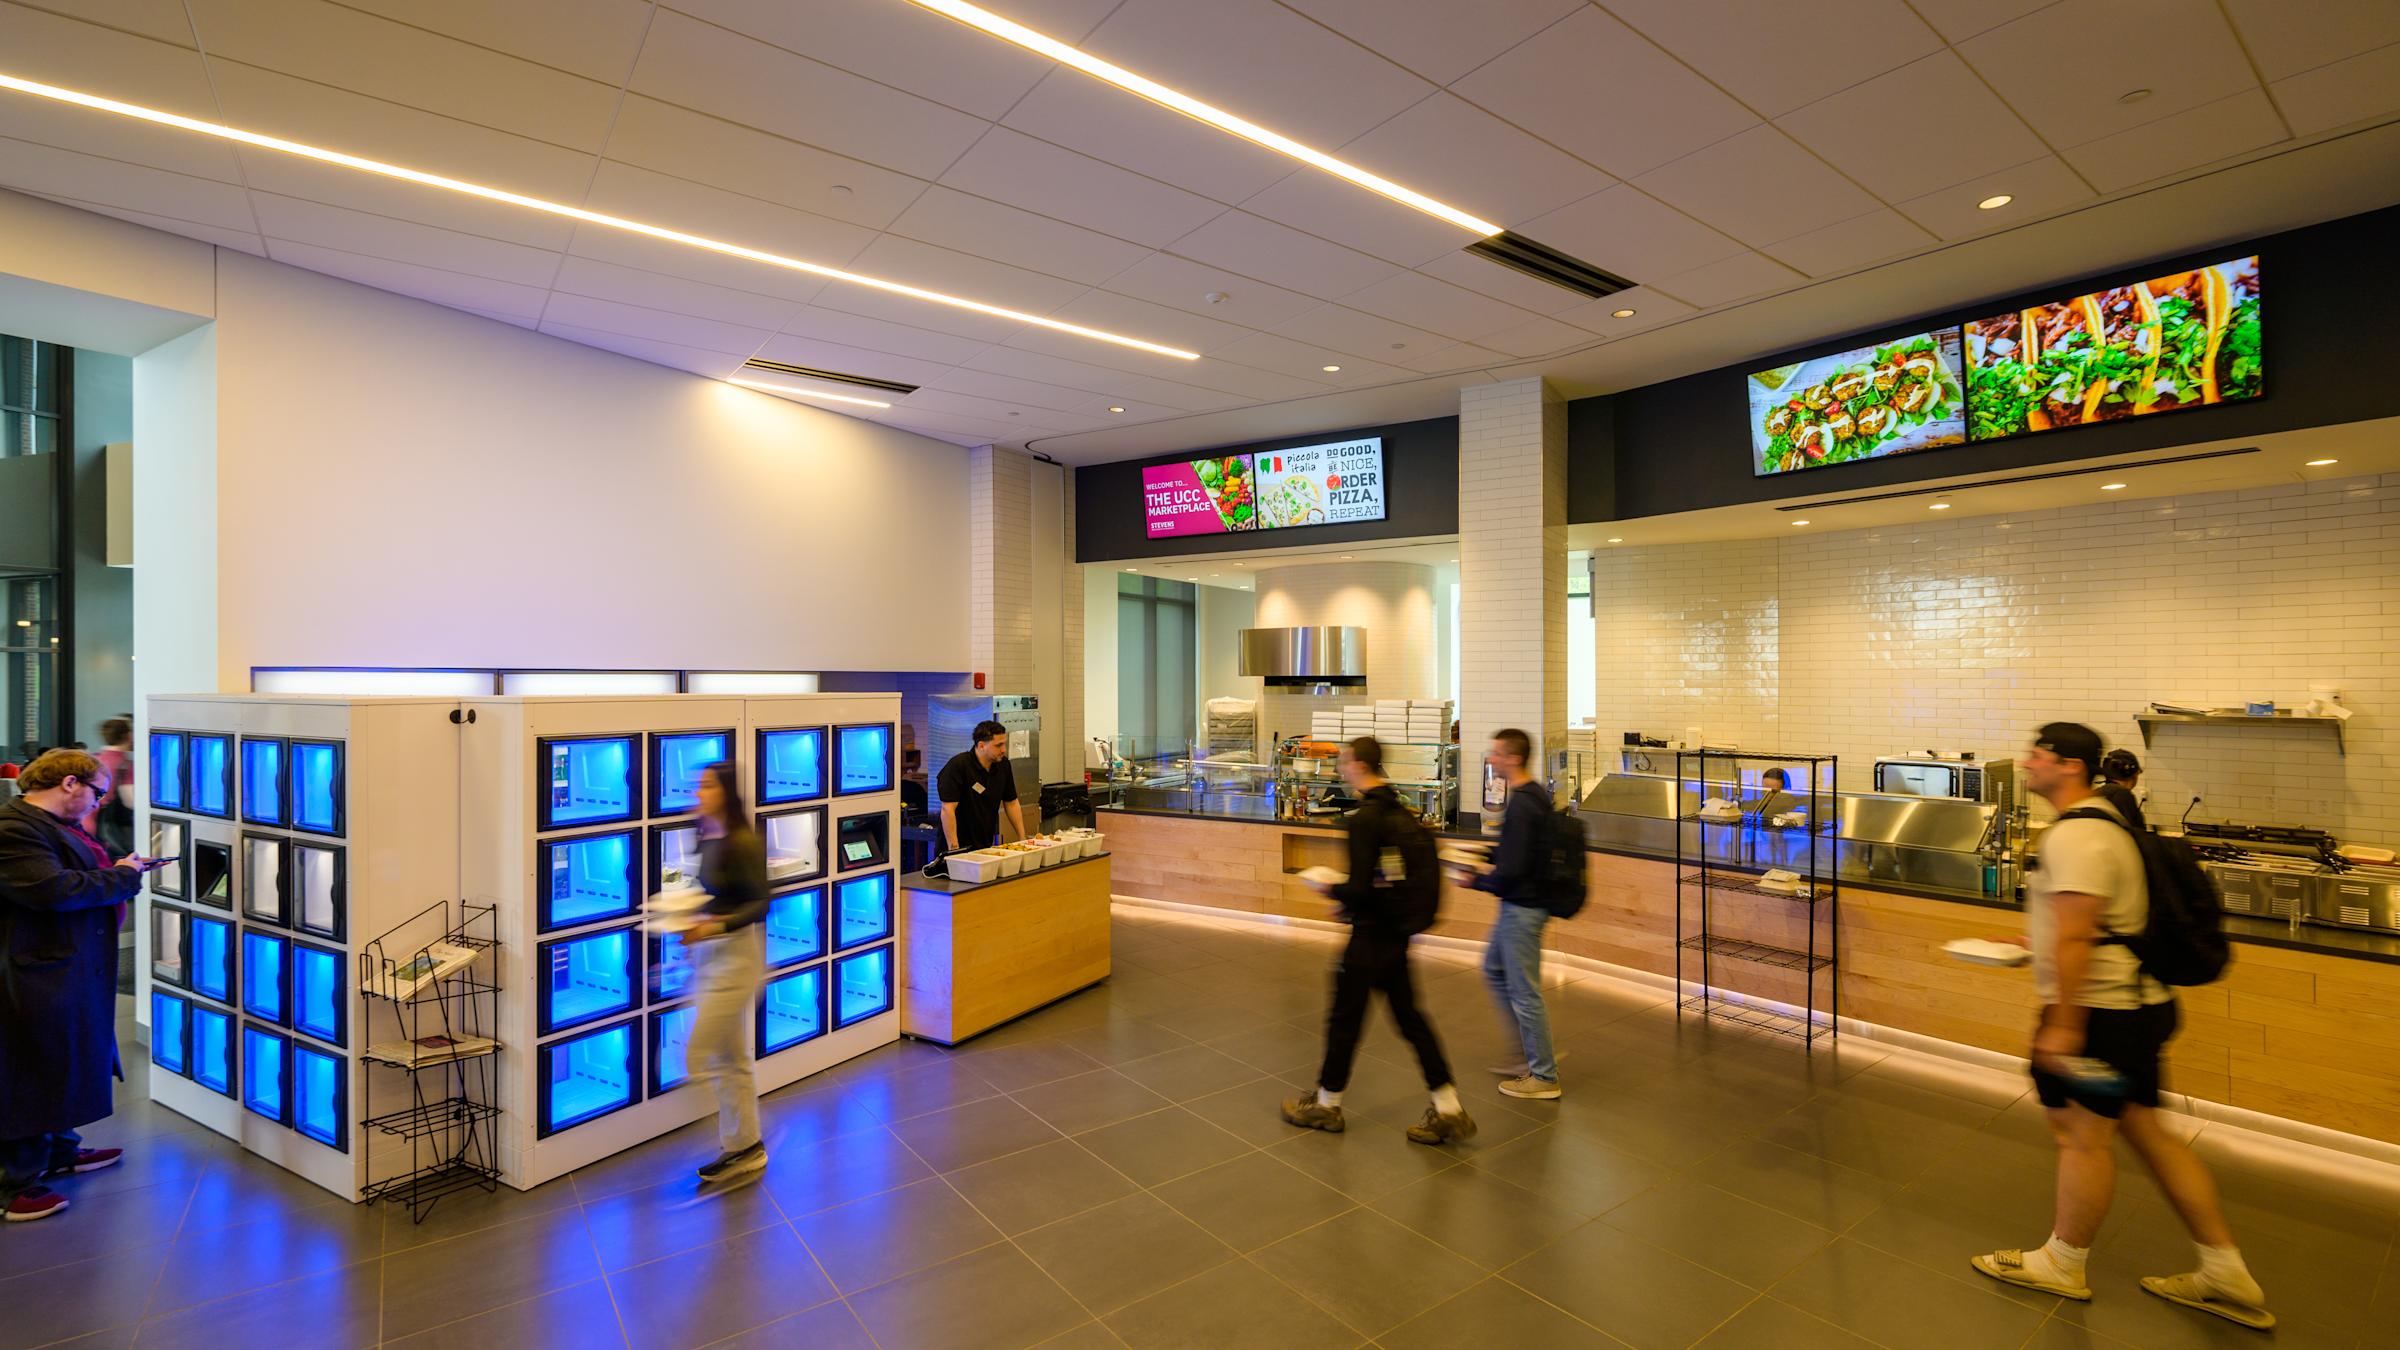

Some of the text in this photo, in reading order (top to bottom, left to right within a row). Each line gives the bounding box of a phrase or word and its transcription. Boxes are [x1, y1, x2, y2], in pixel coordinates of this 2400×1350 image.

[1327, 444, 1376, 457] DO GOOD,
[1287, 451, 1320, 465] piccola
[1291, 463, 1316, 473] italia
[1328, 458, 1377, 472] BE NICE,
[1146, 481, 1174, 490] WELCOME
[1146, 489, 1201, 507] THE UCC
[1329, 489, 1378, 506] PIZZA,
[1148, 502, 1211, 517] MARKETPLACE
[1330, 506, 1380, 519] REPEAT
[1151, 521, 1175, 529] STEVENS
